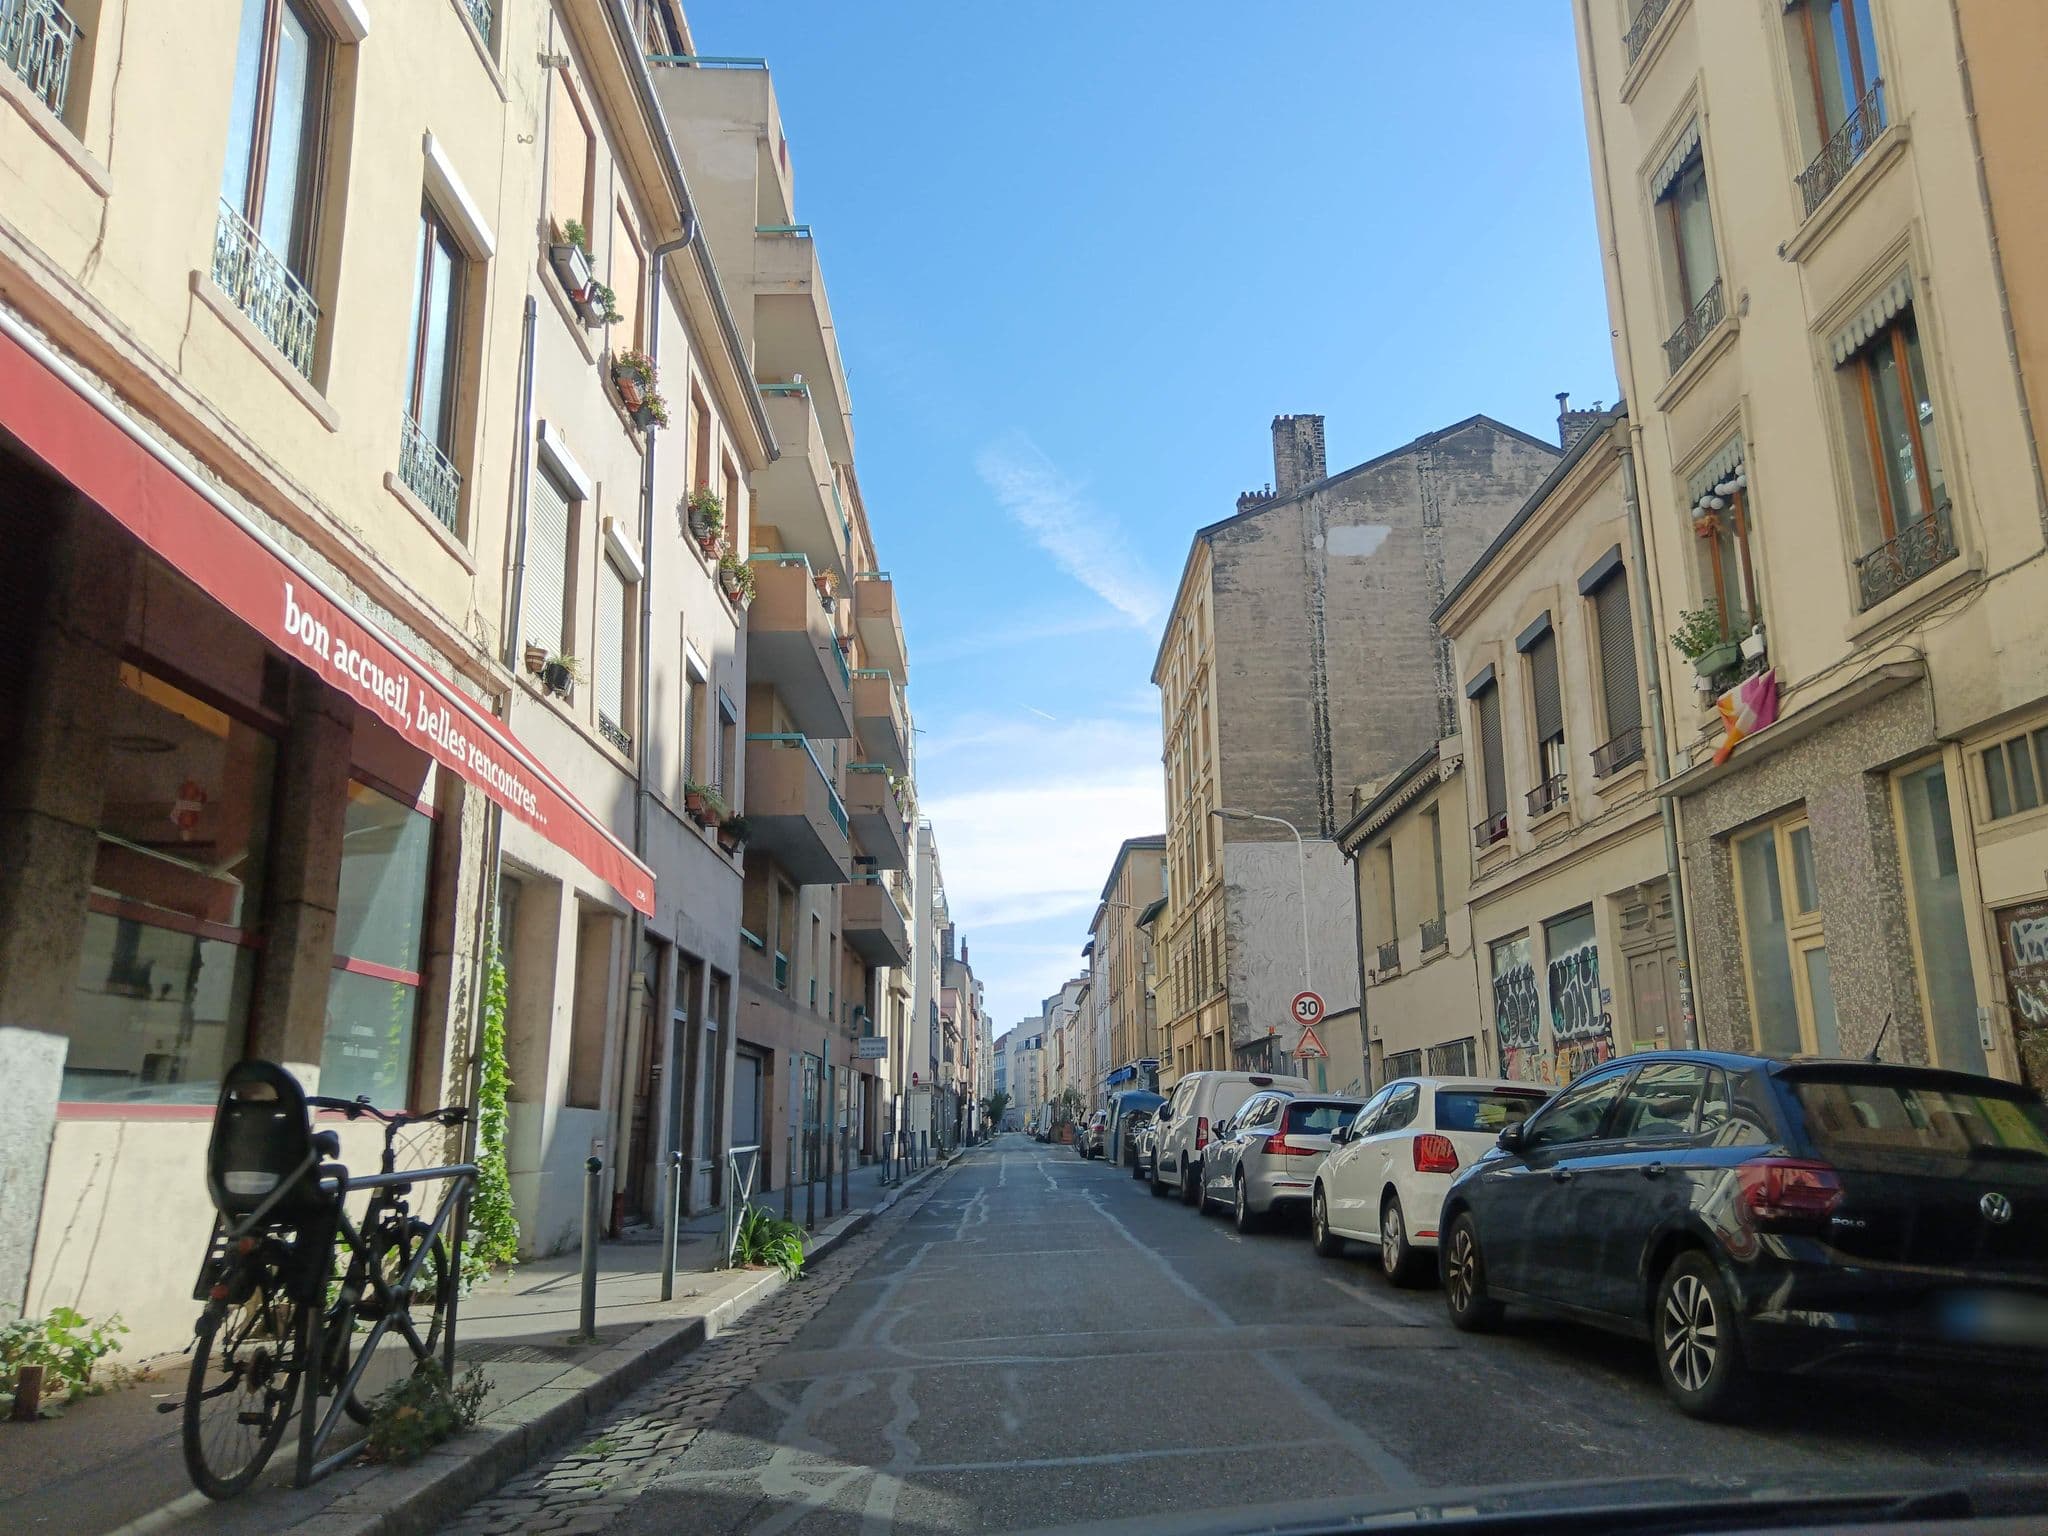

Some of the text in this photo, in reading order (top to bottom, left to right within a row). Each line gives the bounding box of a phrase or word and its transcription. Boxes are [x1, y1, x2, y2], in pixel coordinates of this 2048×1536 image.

[284, 583, 548, 825] bon accueil, belles rencontres...
[1298, 1001, 1318, 1016] 30
